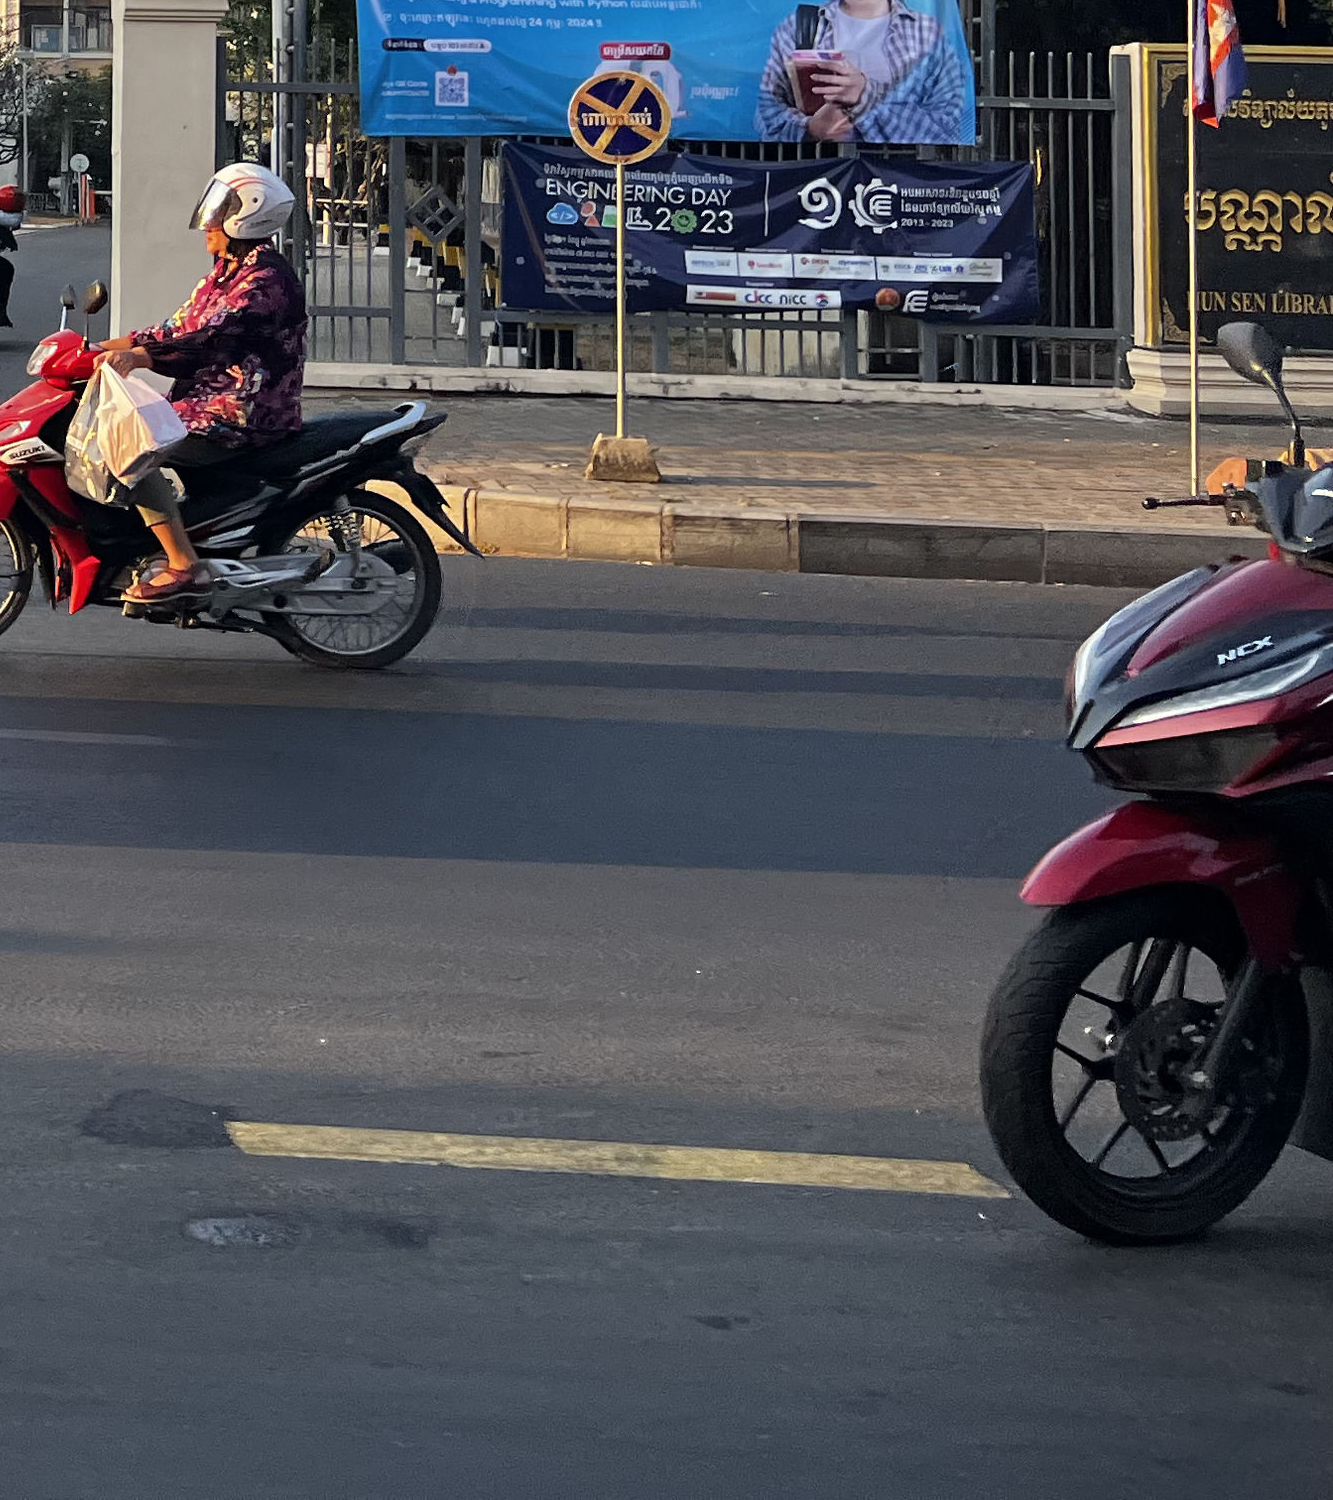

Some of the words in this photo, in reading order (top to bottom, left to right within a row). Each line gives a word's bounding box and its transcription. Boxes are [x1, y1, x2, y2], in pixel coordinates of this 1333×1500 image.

[587, 0, 627, 10] Python
[691, 187, 732, 206] DAY
[1231, 292, 1267, 312] SEN
[1271, 293, 1333, 315] LIBRA
[9, 445, 46, 460] SUZUKI
